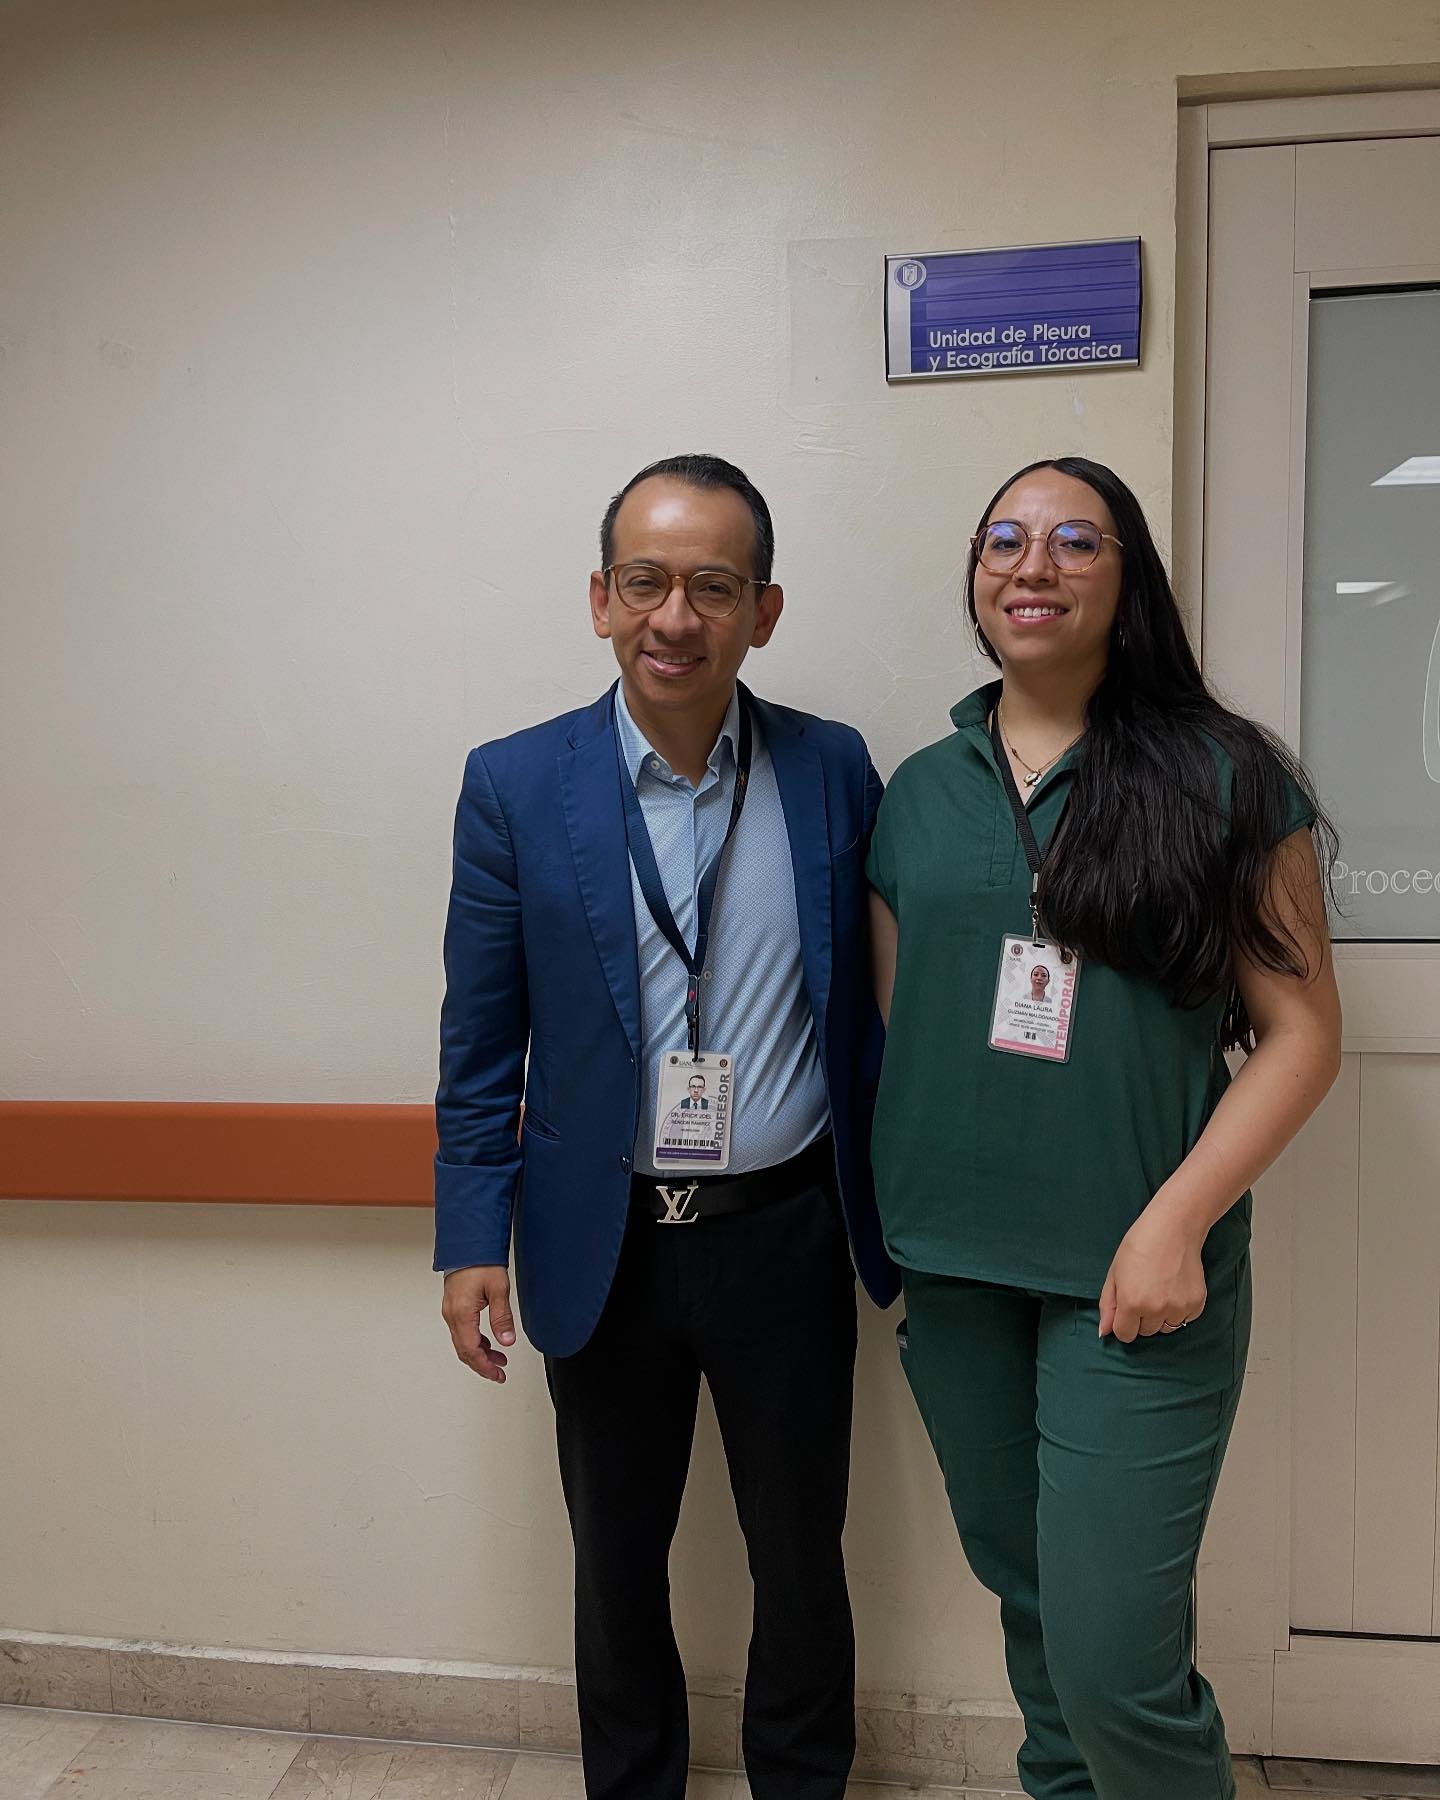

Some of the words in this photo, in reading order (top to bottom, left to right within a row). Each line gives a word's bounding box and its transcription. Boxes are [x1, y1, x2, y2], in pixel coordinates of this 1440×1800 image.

[929, 326, 996, 348] Unidad
[1001, 325, 1027, 344] de
[1033, 323, 1091, 342] Pleura
[929, 355, 941, 373] y
[947, 346, 1034, 369] Ecografía
[1040, 342, 1122, 362] Tóracica
[1325, 860, 1440, 894] Proce
[1014, 1001, 1032, 1010] DIANA
[1033, 1004, 1053, 1014] LAURA
[1056, 968, 1076, 1052] TEMPORAL
[713, 1074, 730, 1150] PROFESOR
